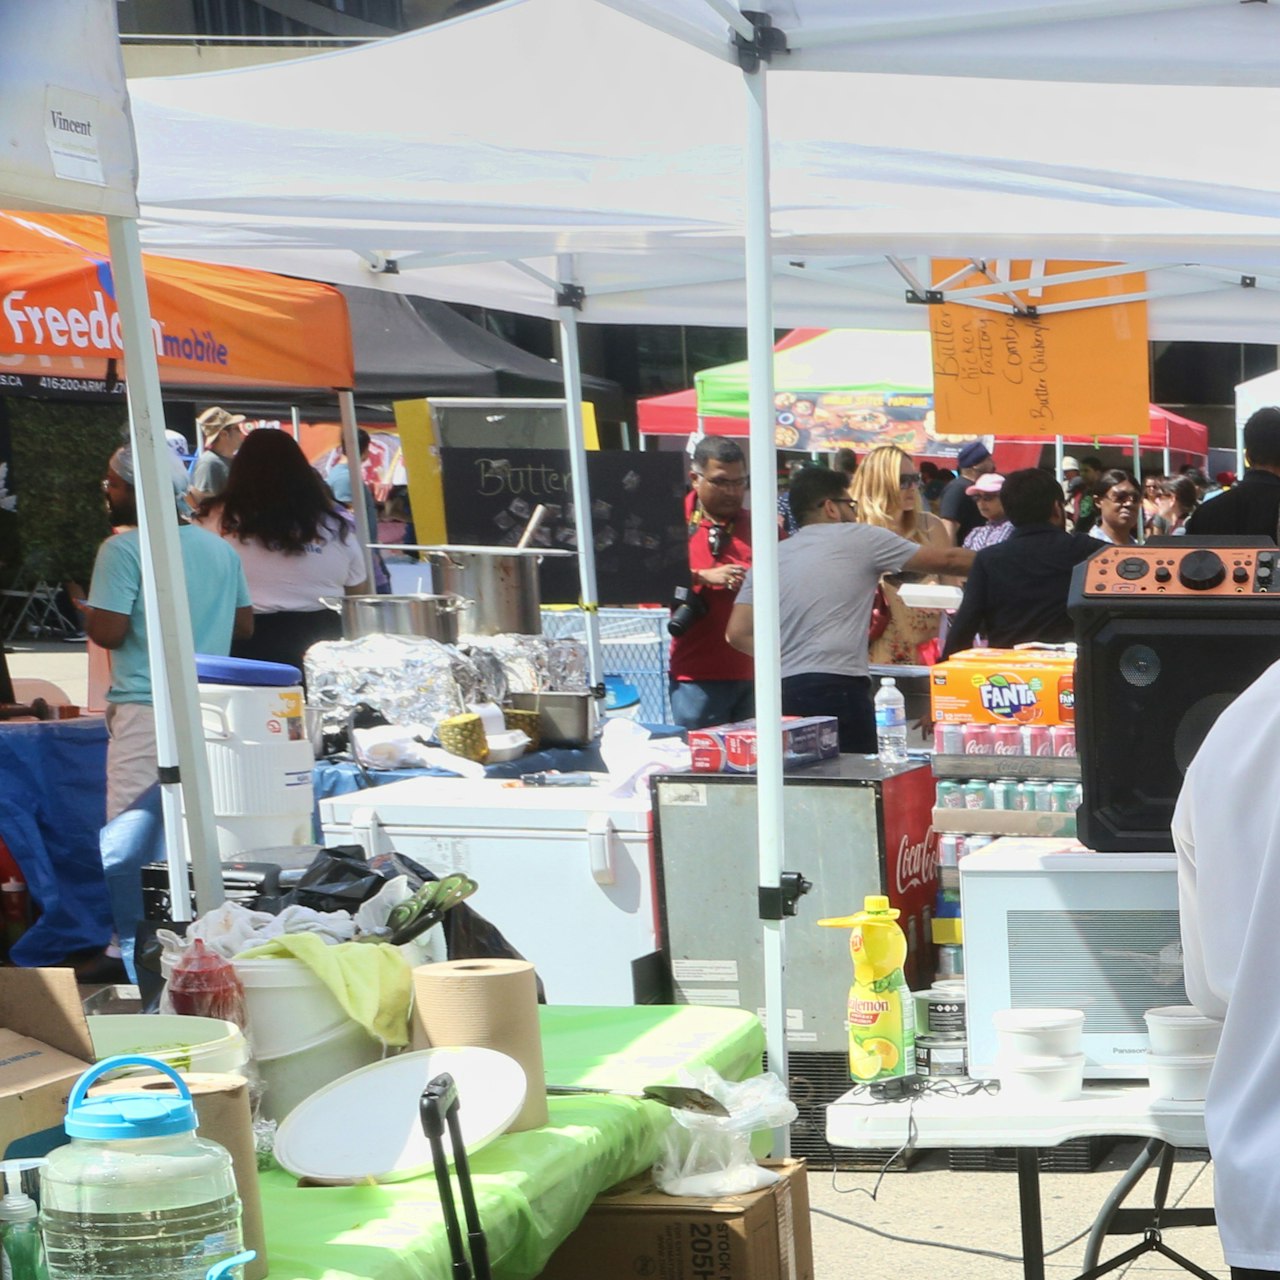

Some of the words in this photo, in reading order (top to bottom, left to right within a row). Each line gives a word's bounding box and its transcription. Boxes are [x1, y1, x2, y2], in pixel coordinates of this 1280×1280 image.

[50, 110, 92, 137] Vincent
[162, 328, 228, 365] mobile
[979, 683, 1038, 709] FANTA
[716, 1222, 732, 1275] STOCK
